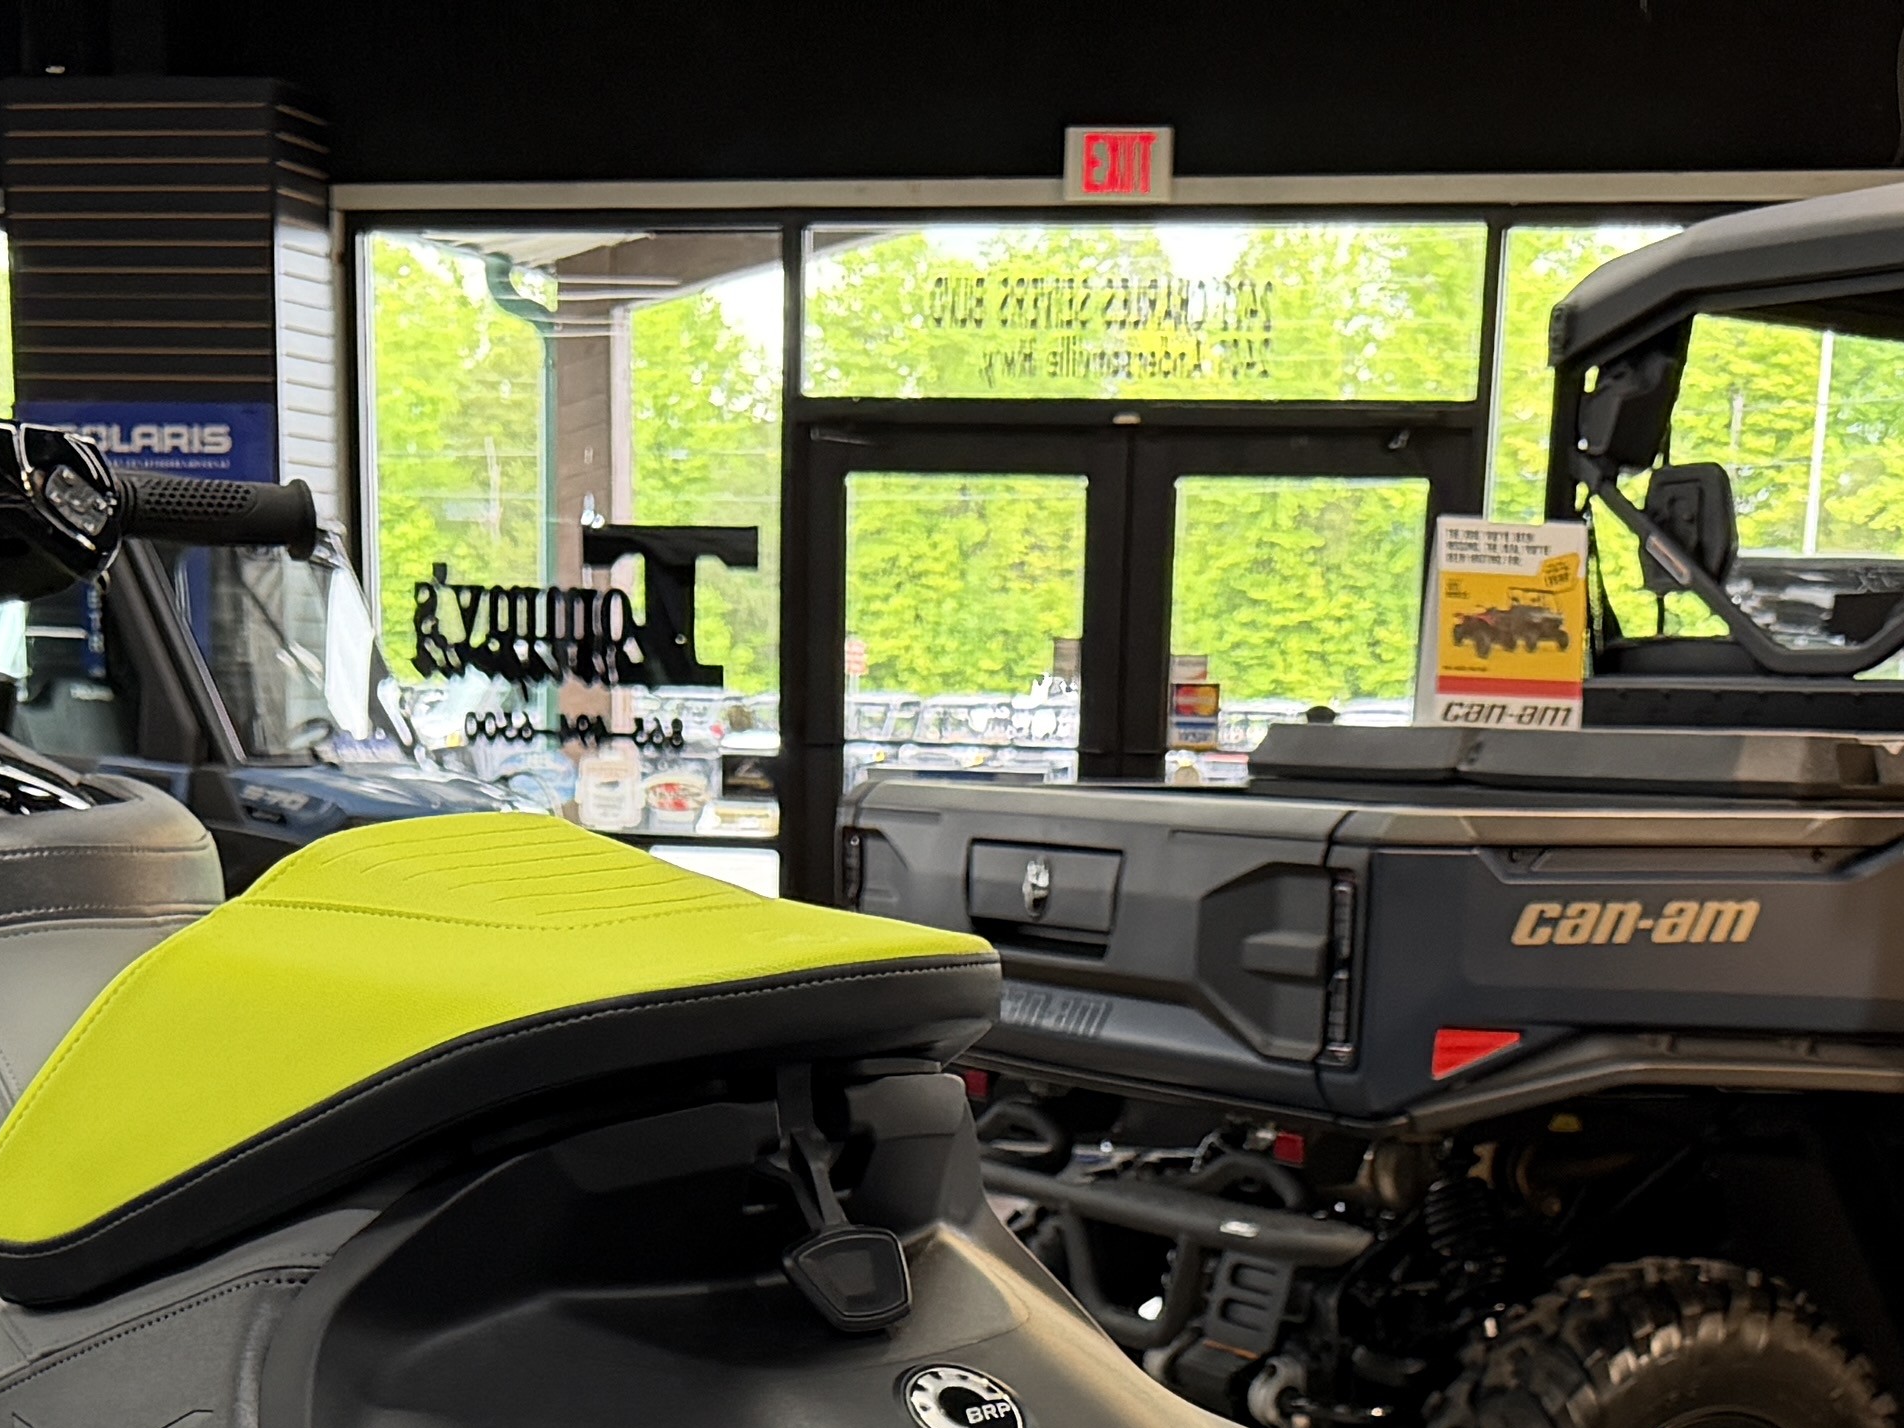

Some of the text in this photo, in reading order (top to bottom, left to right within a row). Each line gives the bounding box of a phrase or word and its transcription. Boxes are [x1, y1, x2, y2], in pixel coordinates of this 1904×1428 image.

[1082, 131, 1157, 194] EXIT
[1443, 702, 1573, 726] can-am
[1511, 900, 1760, 946] can-am
[966, 1402, 1011, 1424] BRP
